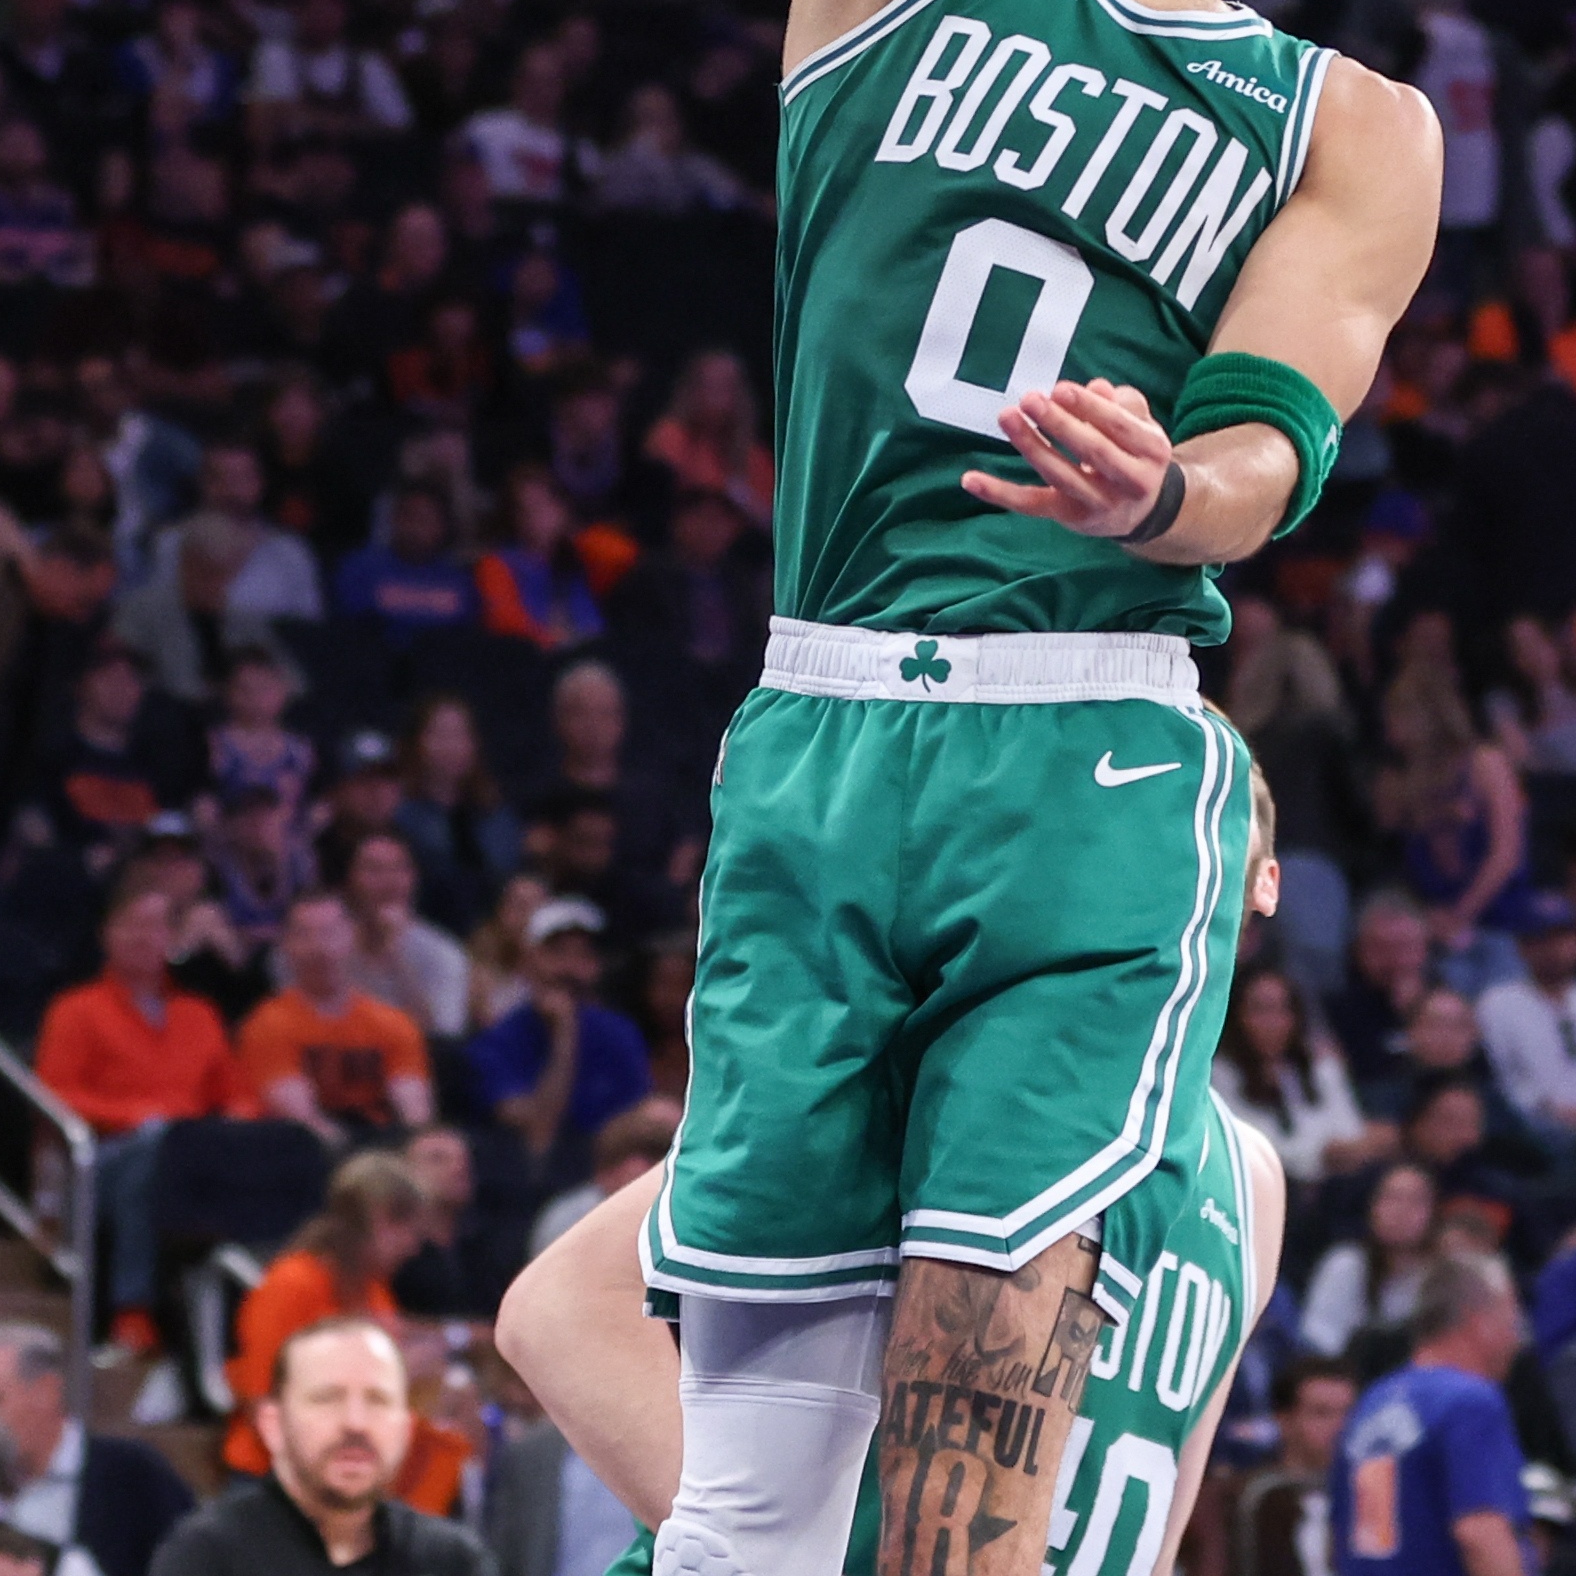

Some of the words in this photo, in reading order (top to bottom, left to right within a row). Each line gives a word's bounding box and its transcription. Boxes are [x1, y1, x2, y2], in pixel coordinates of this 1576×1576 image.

[875, 15, 1272, 312] BOSTON
[1187, 60, 1288, 113] Amica
[904, 217, 1094, 442] 0
